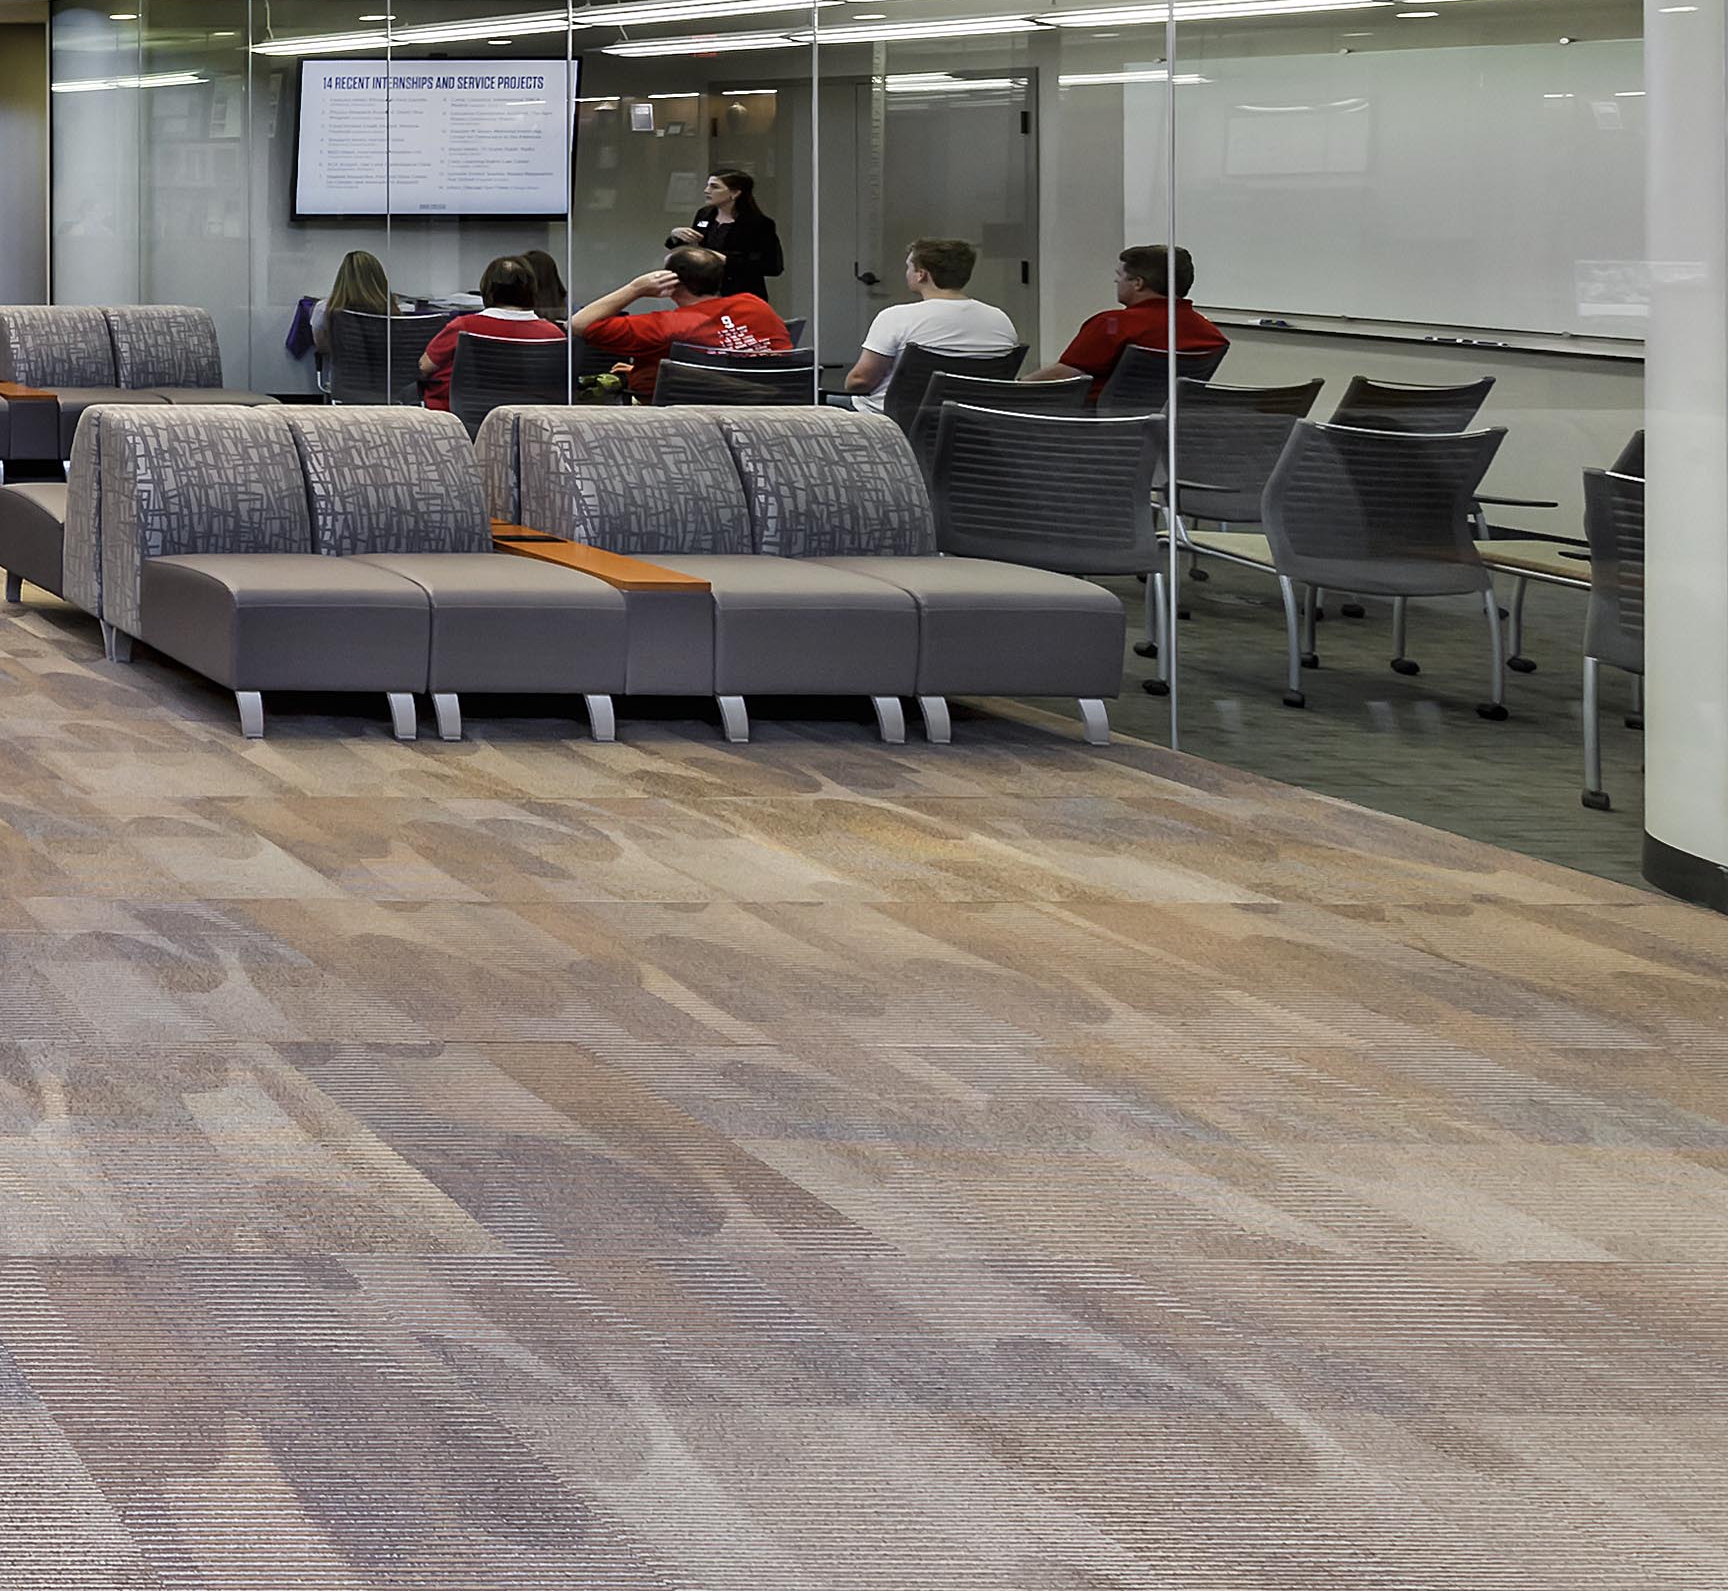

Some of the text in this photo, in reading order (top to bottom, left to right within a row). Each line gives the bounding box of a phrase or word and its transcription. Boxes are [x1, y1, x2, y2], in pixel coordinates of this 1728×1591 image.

[323, 76, 544, 90] 14 RECENT INTERNSHIPS AND SERVICE PROJECTS
